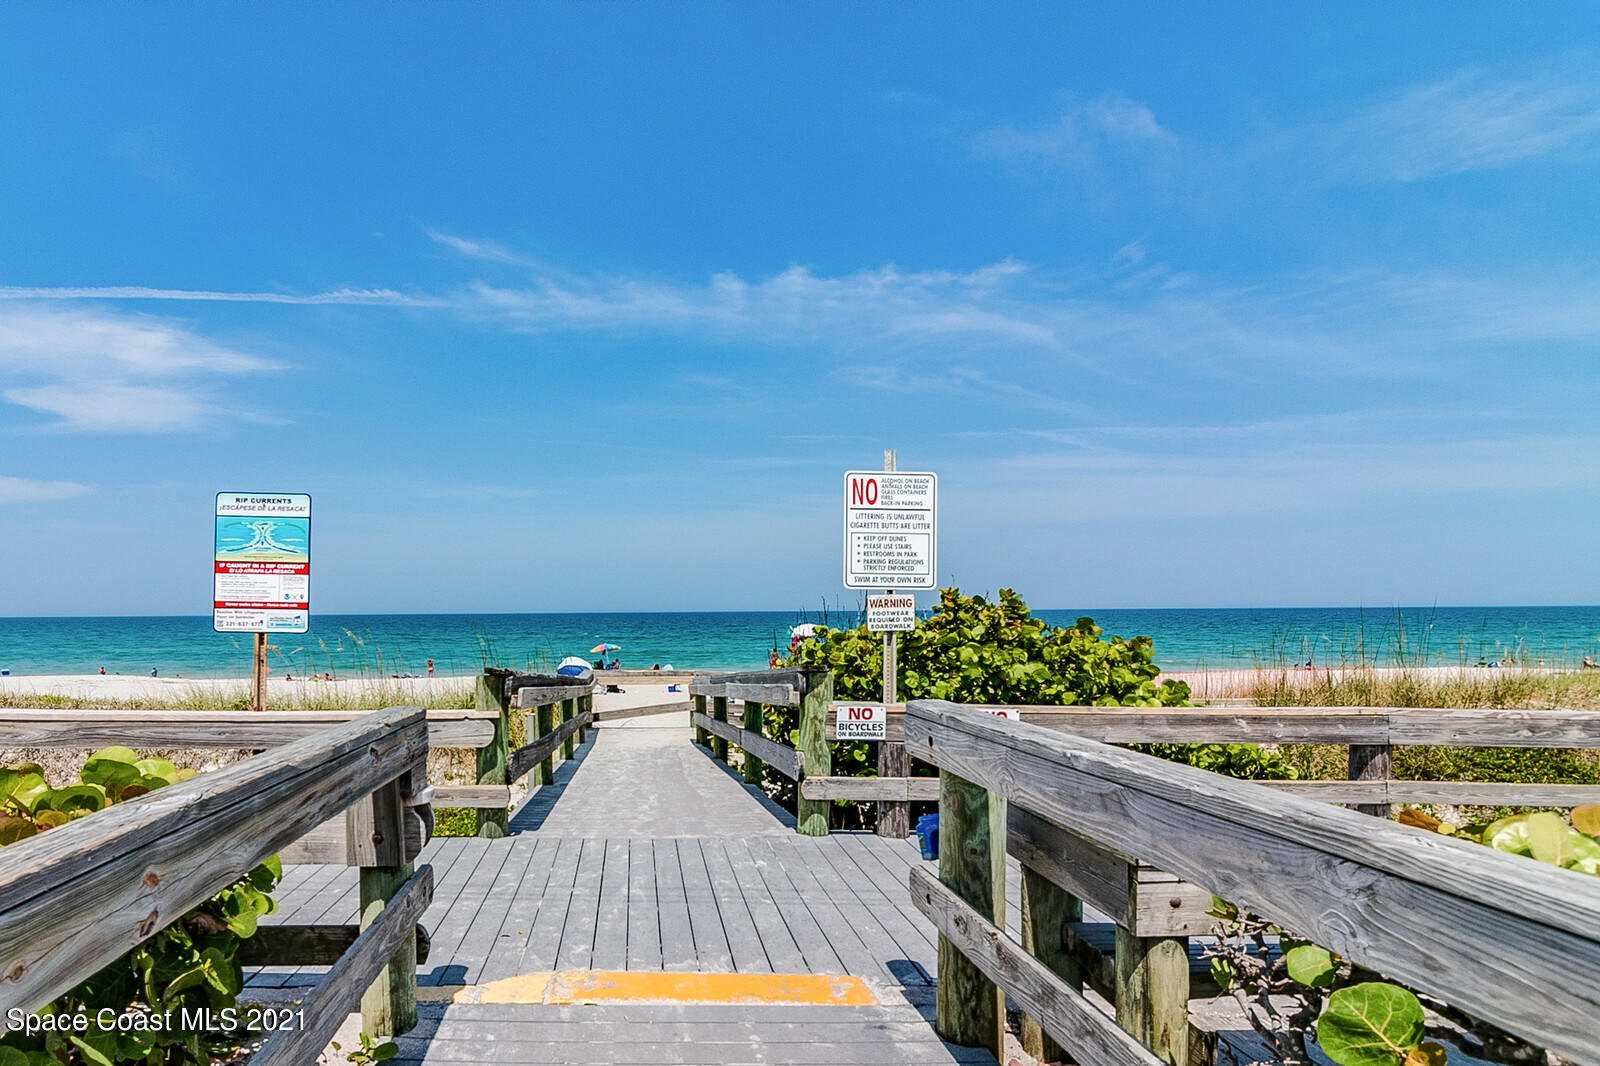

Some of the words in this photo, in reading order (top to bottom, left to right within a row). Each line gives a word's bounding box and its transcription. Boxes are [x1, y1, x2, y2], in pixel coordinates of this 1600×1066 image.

[852, 478, 878, 505] NO
[869, 599, 912, 608] WARNING
[848, 708, 873, 720] NO
